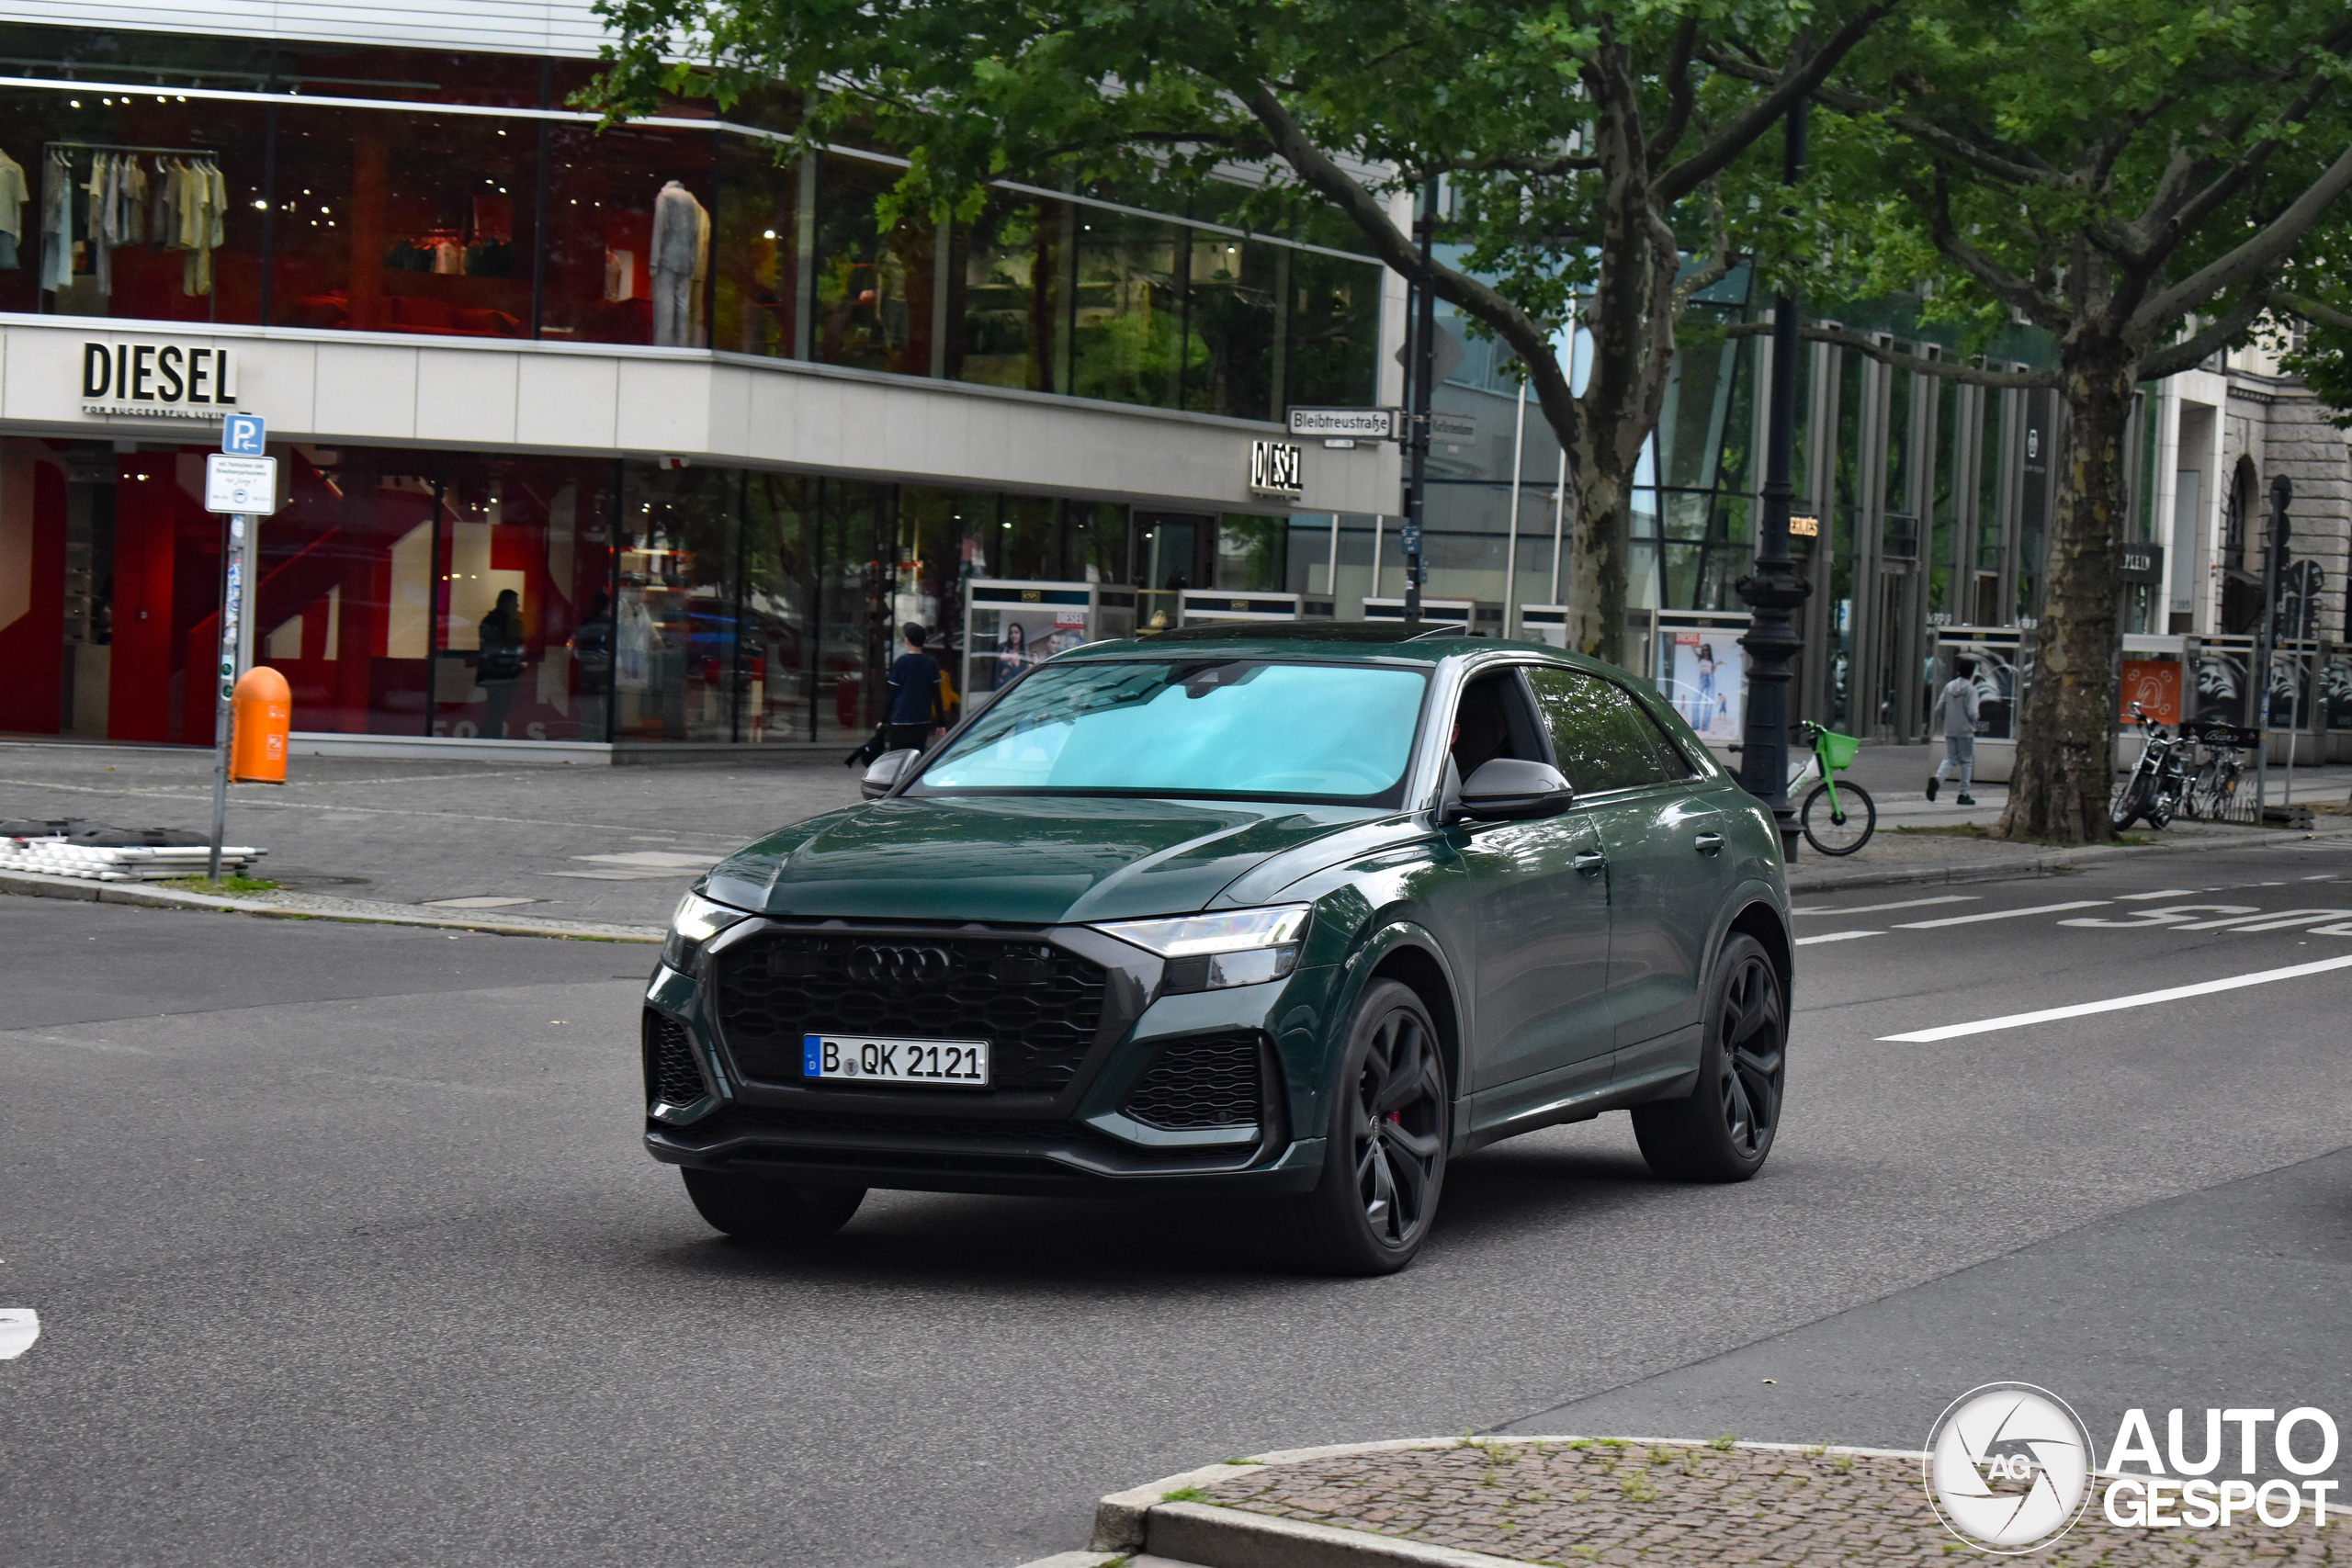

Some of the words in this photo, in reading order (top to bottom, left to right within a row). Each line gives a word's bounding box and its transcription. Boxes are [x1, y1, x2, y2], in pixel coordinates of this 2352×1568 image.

[83, 342, 237, 405] DIESEL
[82, 405, 107, 414] FOR
[111, 407, 190, 418] SUCCESSFUL
[1294, 412, 1388, 433] Bleibtreustraße
[232, 419, 256, 450] P
[1250, 440, 1304, 491] DIESEL
[822, 1041, 841, 1073] B
[861, 1043, 899, 1076] QK
[906, 1045, 981, 1079] 2121
